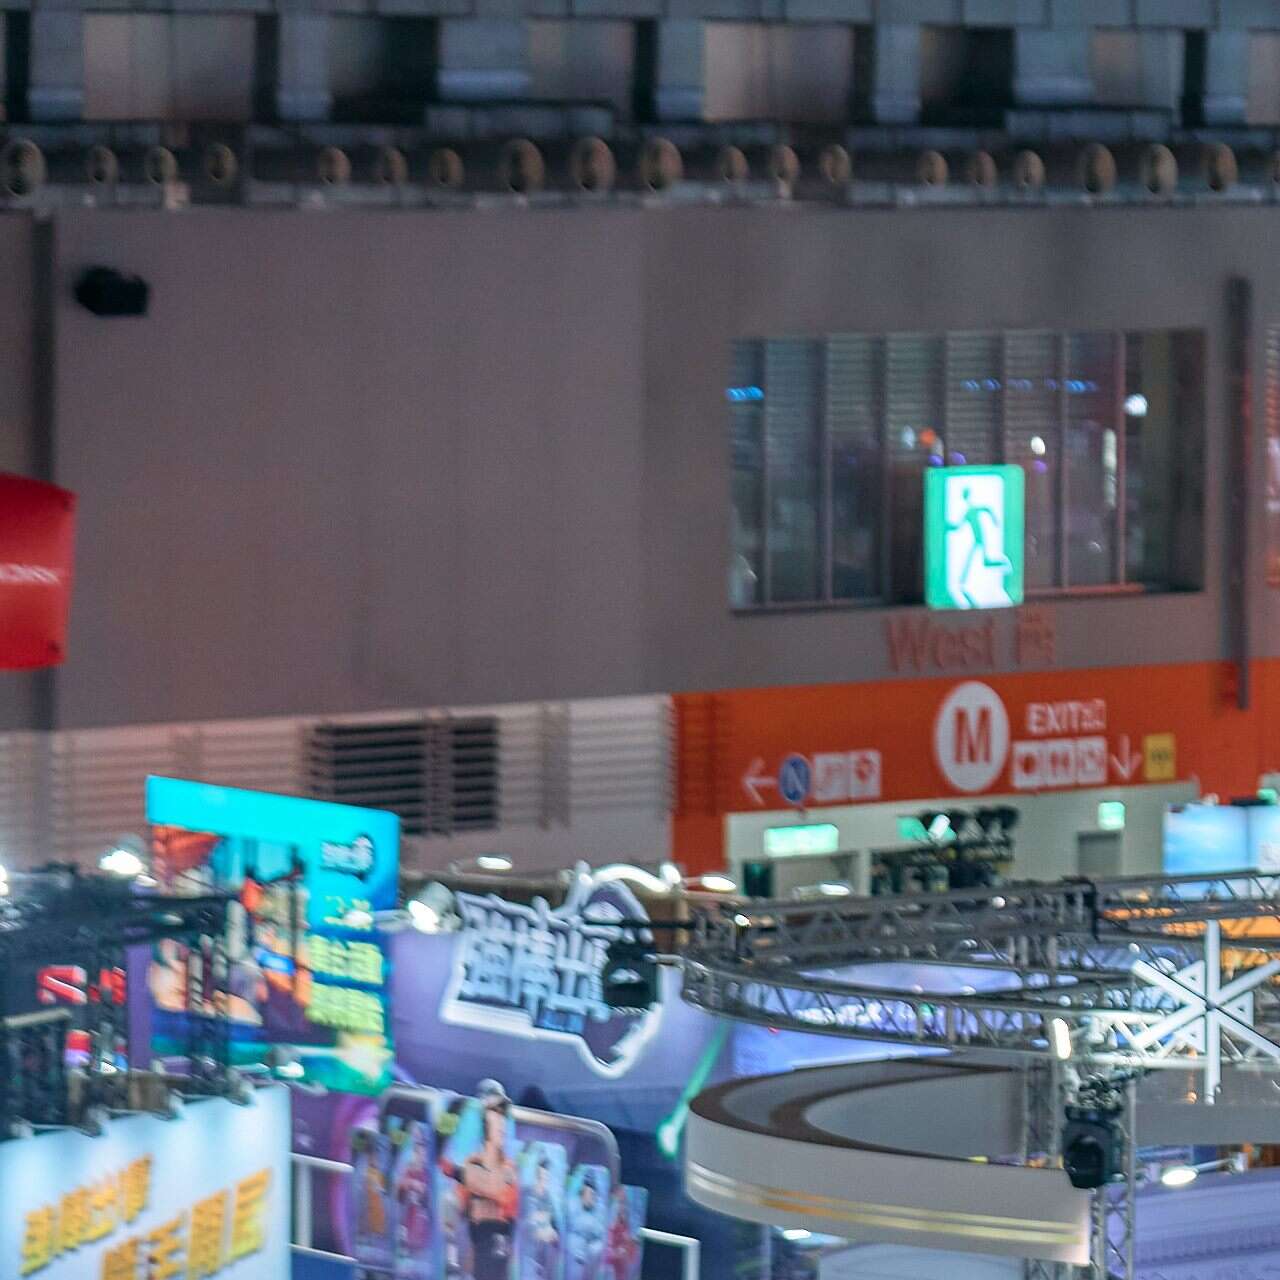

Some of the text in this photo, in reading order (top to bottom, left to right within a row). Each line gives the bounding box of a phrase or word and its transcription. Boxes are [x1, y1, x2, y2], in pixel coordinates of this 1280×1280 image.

[885, 614, 994, 672] West
[954, 706, 992, 766] M
[1026, 702, 1080, 734] EXIT
